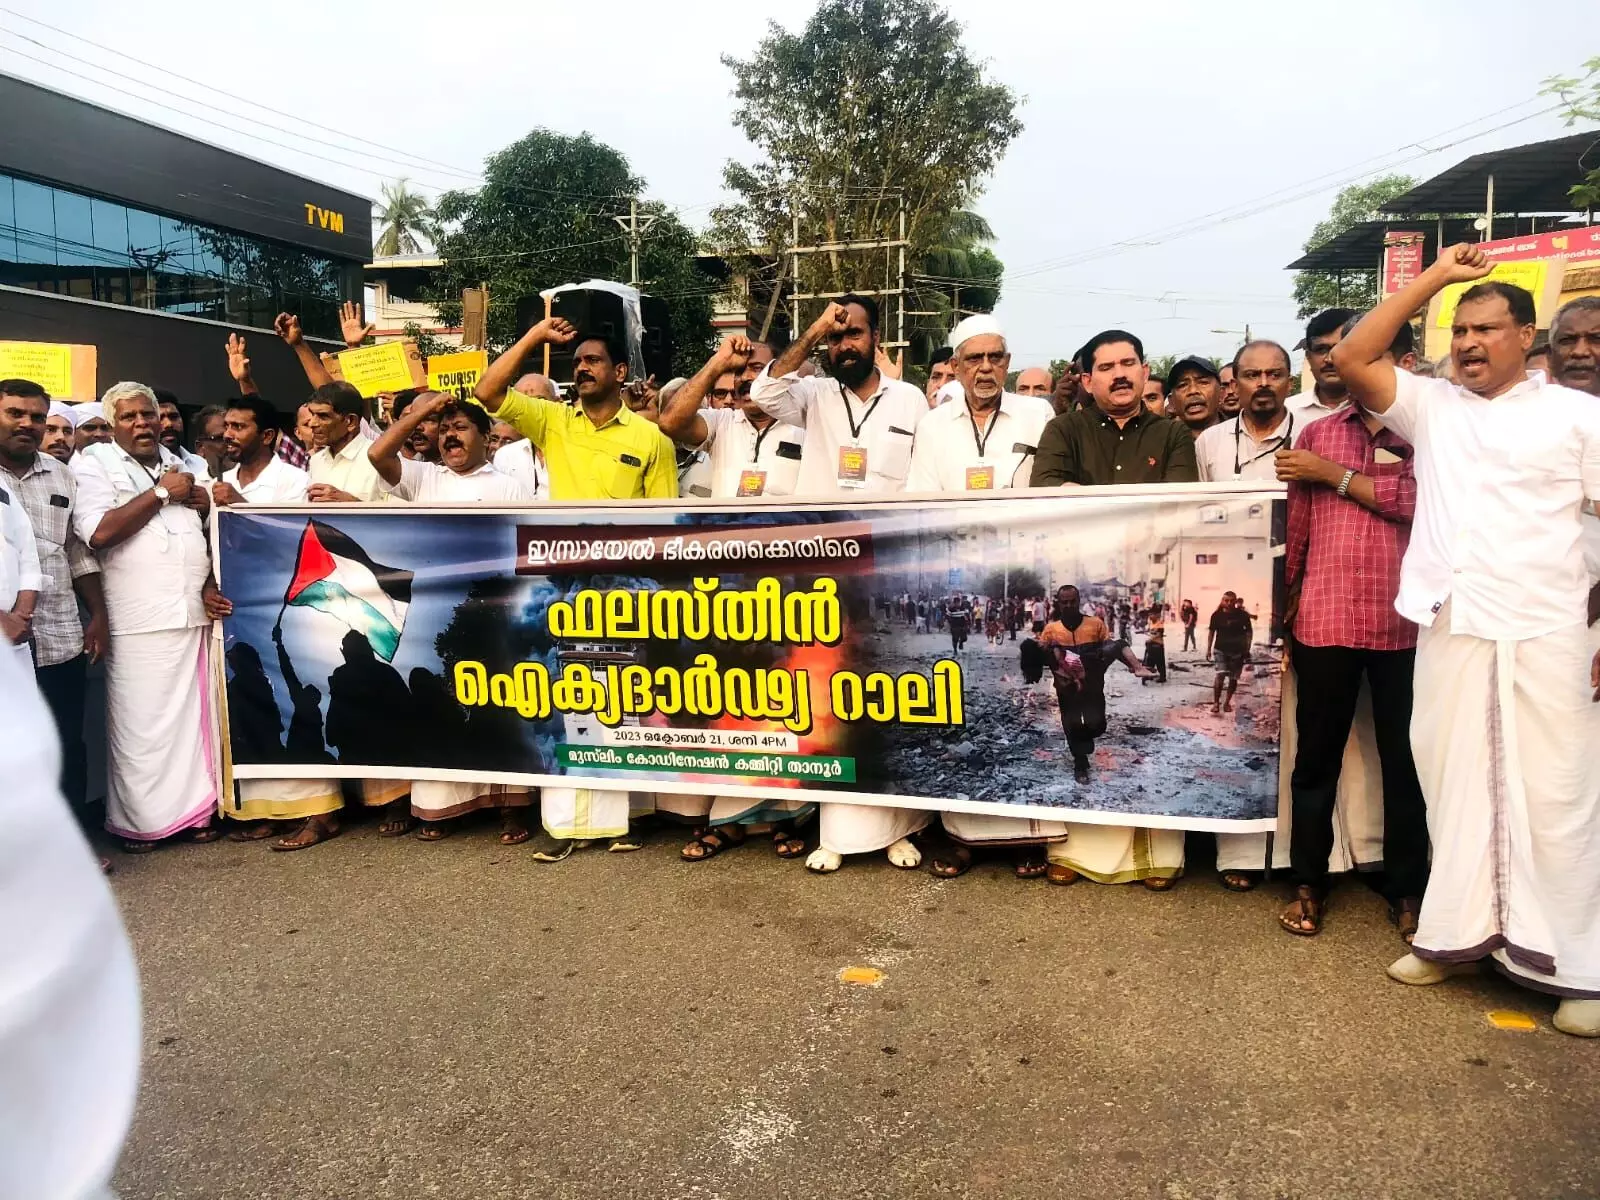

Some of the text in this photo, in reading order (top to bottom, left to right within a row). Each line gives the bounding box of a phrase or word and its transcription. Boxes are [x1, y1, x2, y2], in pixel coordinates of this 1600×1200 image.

[304, 203, 344, 234] TVM
[437, 370, 477, 387] TOURIST
[527, 535, 860, 564] ഇസ്രായേൽ ഭീകരതക്കെതിരെ
[547, 577, 842, 643] ഫലസ്തീൻ
[453, 653, 964, 731] ഐക്യദാർഢ്യ റാലി
[614, 730, 640, 741] 2023
[644, 732, 706, 745] ഒക്ടോബർ
[728, 735, 758, 746] ശനി
[761, 736, 787, 748] 4PM
[626, 751, 730, 769] കോഡിനേഷൻ
[735, 756, 784, 776] കമ്മിറ്റി
[787, 759, 842, 777] താനൂർ
